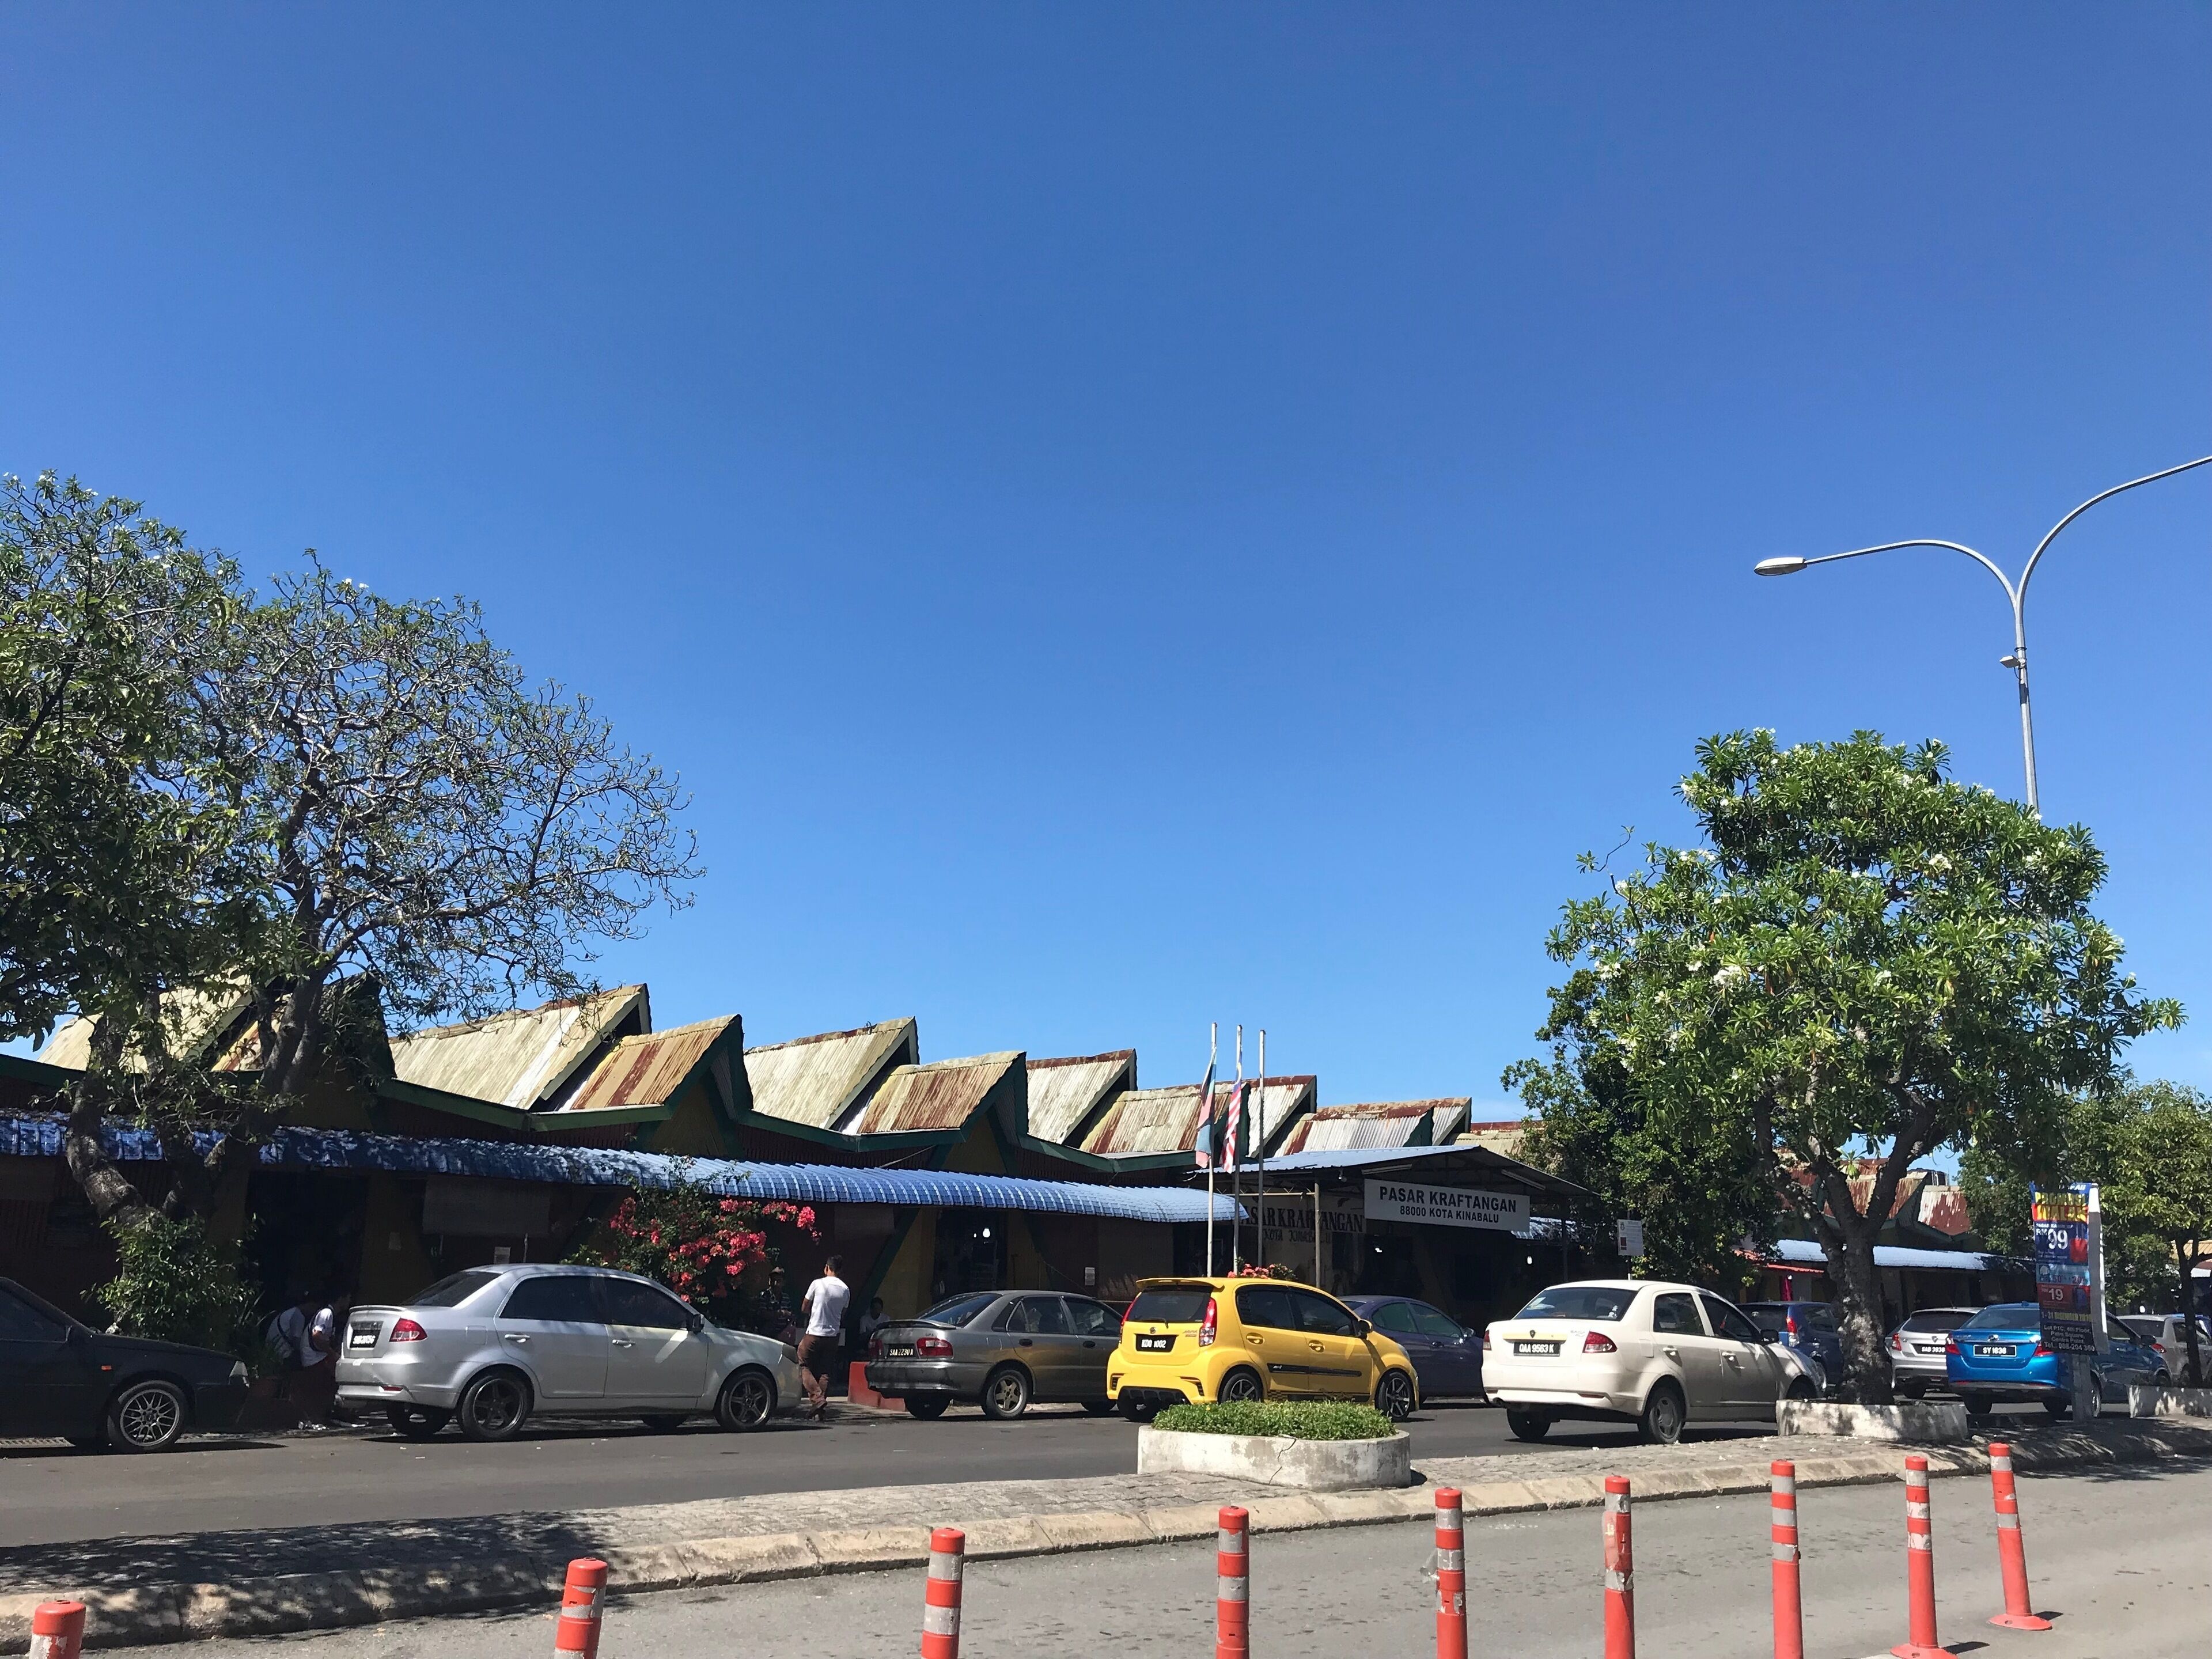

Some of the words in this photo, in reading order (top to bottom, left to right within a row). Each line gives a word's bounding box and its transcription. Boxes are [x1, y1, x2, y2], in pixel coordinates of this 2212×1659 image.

[1380, 1186, 1425, 1204] PASAR
[1430, 1191, 1517, 1213] KRAFTANGAN
[1240, 1206, 1276, 1227] ASAR
[1278, 1208, 1364, 1232] KRAFANGAN
[1400, 1206, 1426, 1217] 88000
[1429, 1208, 1453, 1219] KOTA
[1456, 1211, 1499, 1224] KINABALU
[2048, 1288, 2063, 1301] 19
[1532, 1344, 1548, 1353] 9563
[1549, 1344, 1554, 1353] K
